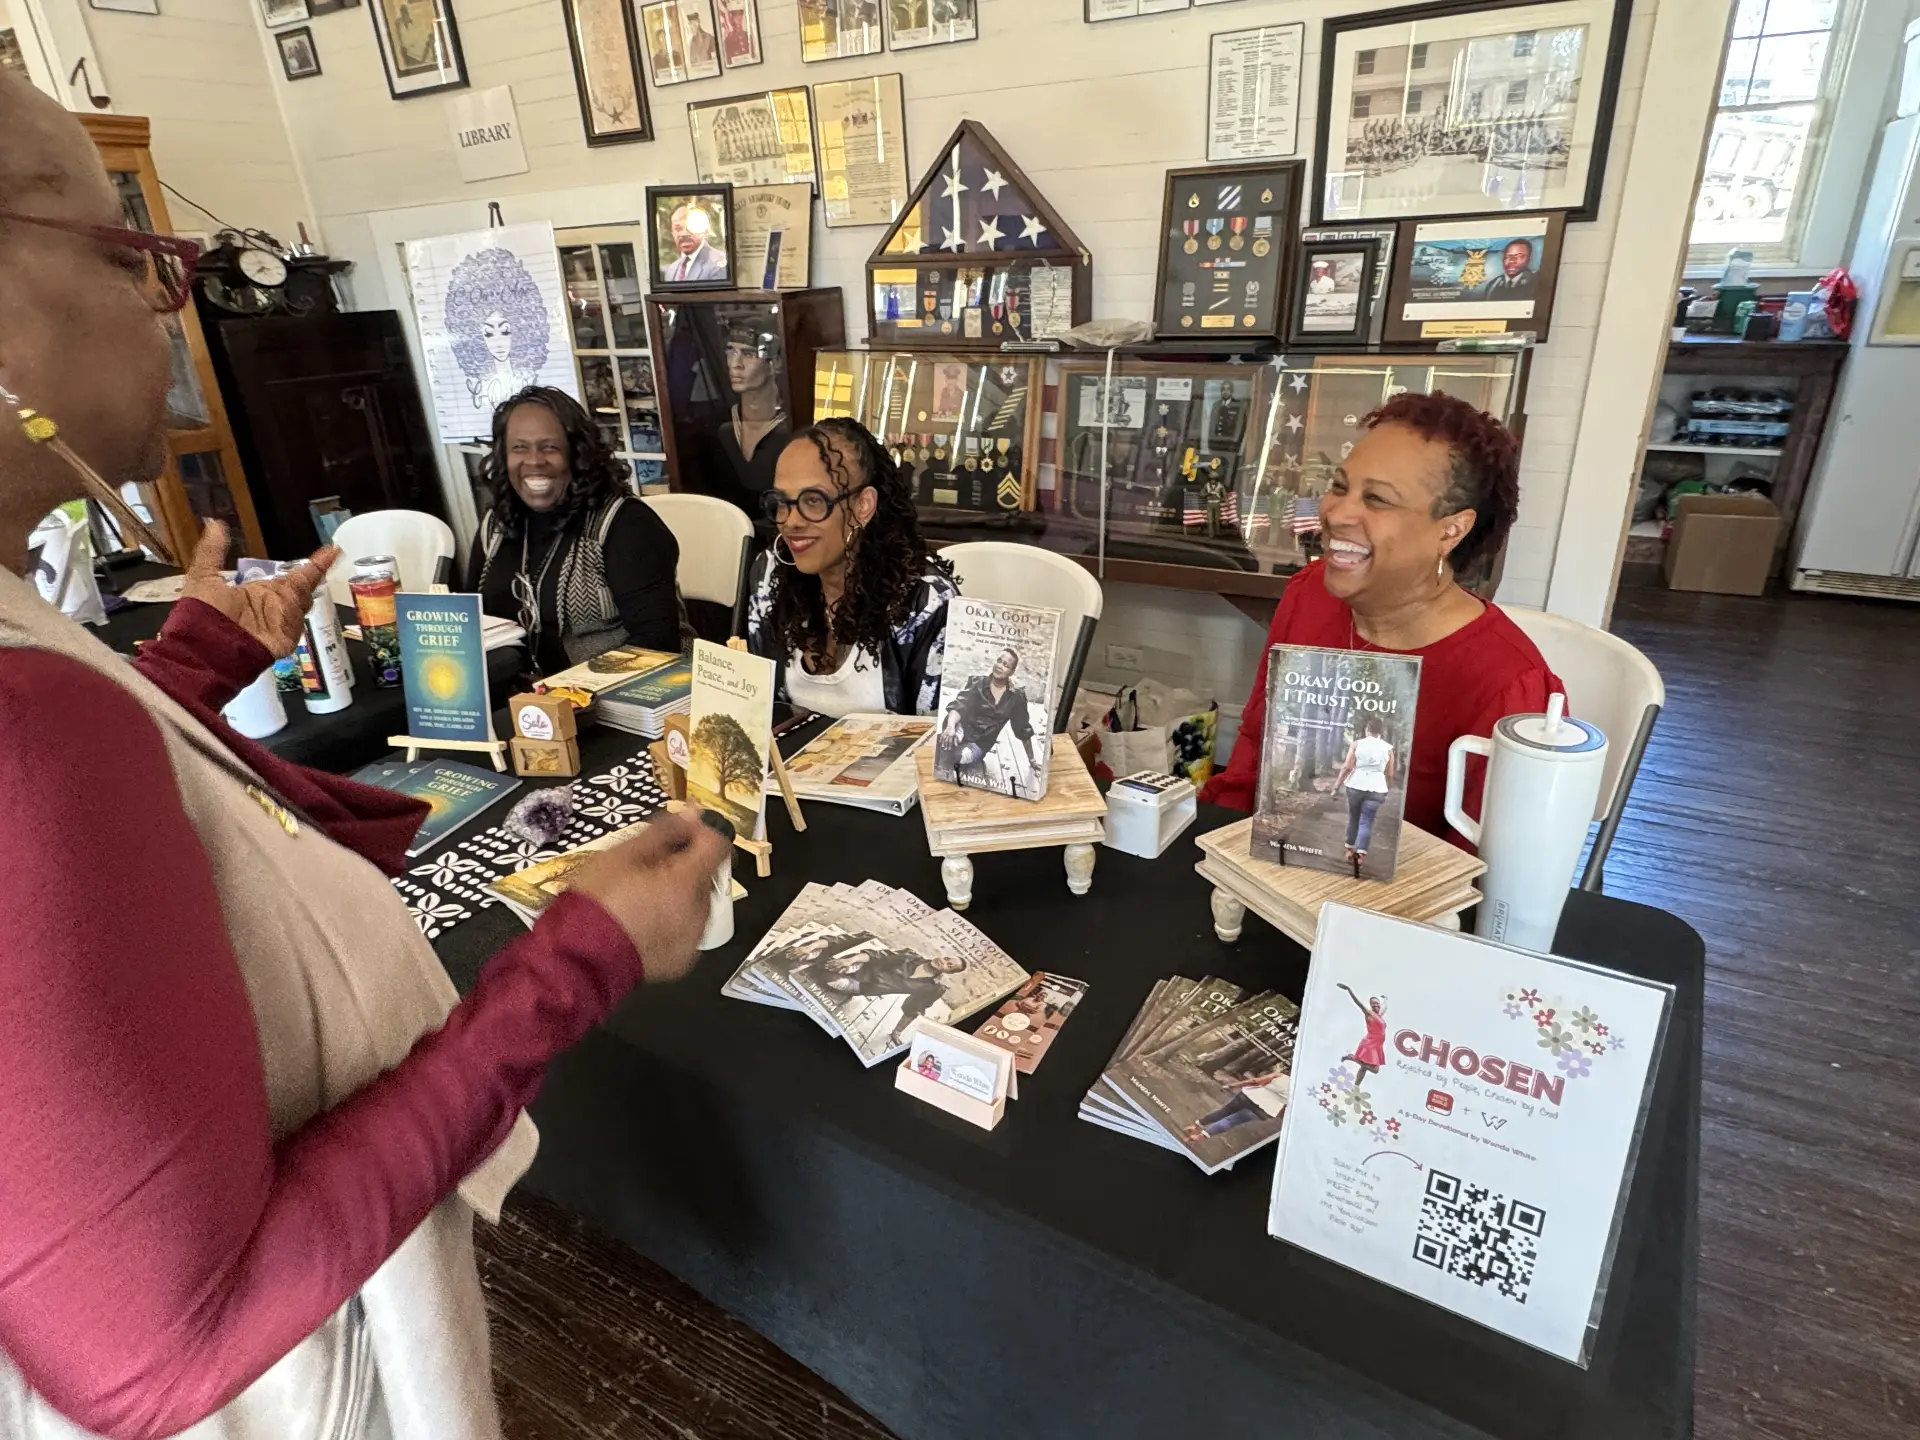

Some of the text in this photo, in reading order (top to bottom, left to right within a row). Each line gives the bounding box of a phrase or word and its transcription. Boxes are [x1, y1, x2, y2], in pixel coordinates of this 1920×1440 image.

[457, 123, 512, 148] LIBRARY
[406, 610, 469, 623] GROWING
[965, 605, 998, 619] OKAY
[415, 623, 463, 634] THROUGH
[974, 620, 996, 633] SEE
[418, 634, 460, 647] GRIEF
[698, 648, 736, 675] Balance,
[697, 664, 725, 686] Peace,
[726, 680, 739, 689] and
[740, 678, 758, 697] Joy
[1284, 671, 1383, 697] OKAY GOD,
[1284, 688, 1397, 714] I TRUST YOU!
[427, 781, 474, 798] GRIEF
[434, 768, 499, 790] GROWING
[434, 775, 484, 793] THROUGH
[1298, 845, 1323, 856] WHITE
[949, 927, 969, 943] SEE
[952, 917, 980, 938] OKAY
[771, 972, 800, 997] WANDA
[809, 983, 837, 1012] WANDA
[1260, 1017, 1293, 1047] TRUS
[1394, 1028, 1566, 1106] CHOSEN
[1130, 1076, 1172, 1114] WANDA WHITE
[1396, 1060, 1432, 1077] Rejected
[1436, 1073, 1448, 1088] by
[1485, 1089, 1517, 1106] Chosen
[1522, 1102, 1535, 1117] by
[1539, 1107, 1559, 1119] God
[1405, 1112, 1427, 1124] 5-Day
[1428, 1119, 1469, 1138] Devotional
[1470, 1133, 1480, 1142] by
[1481, 1137, 1510, 1152] Wanda
[1512, 1147, 1537, 1161] White
